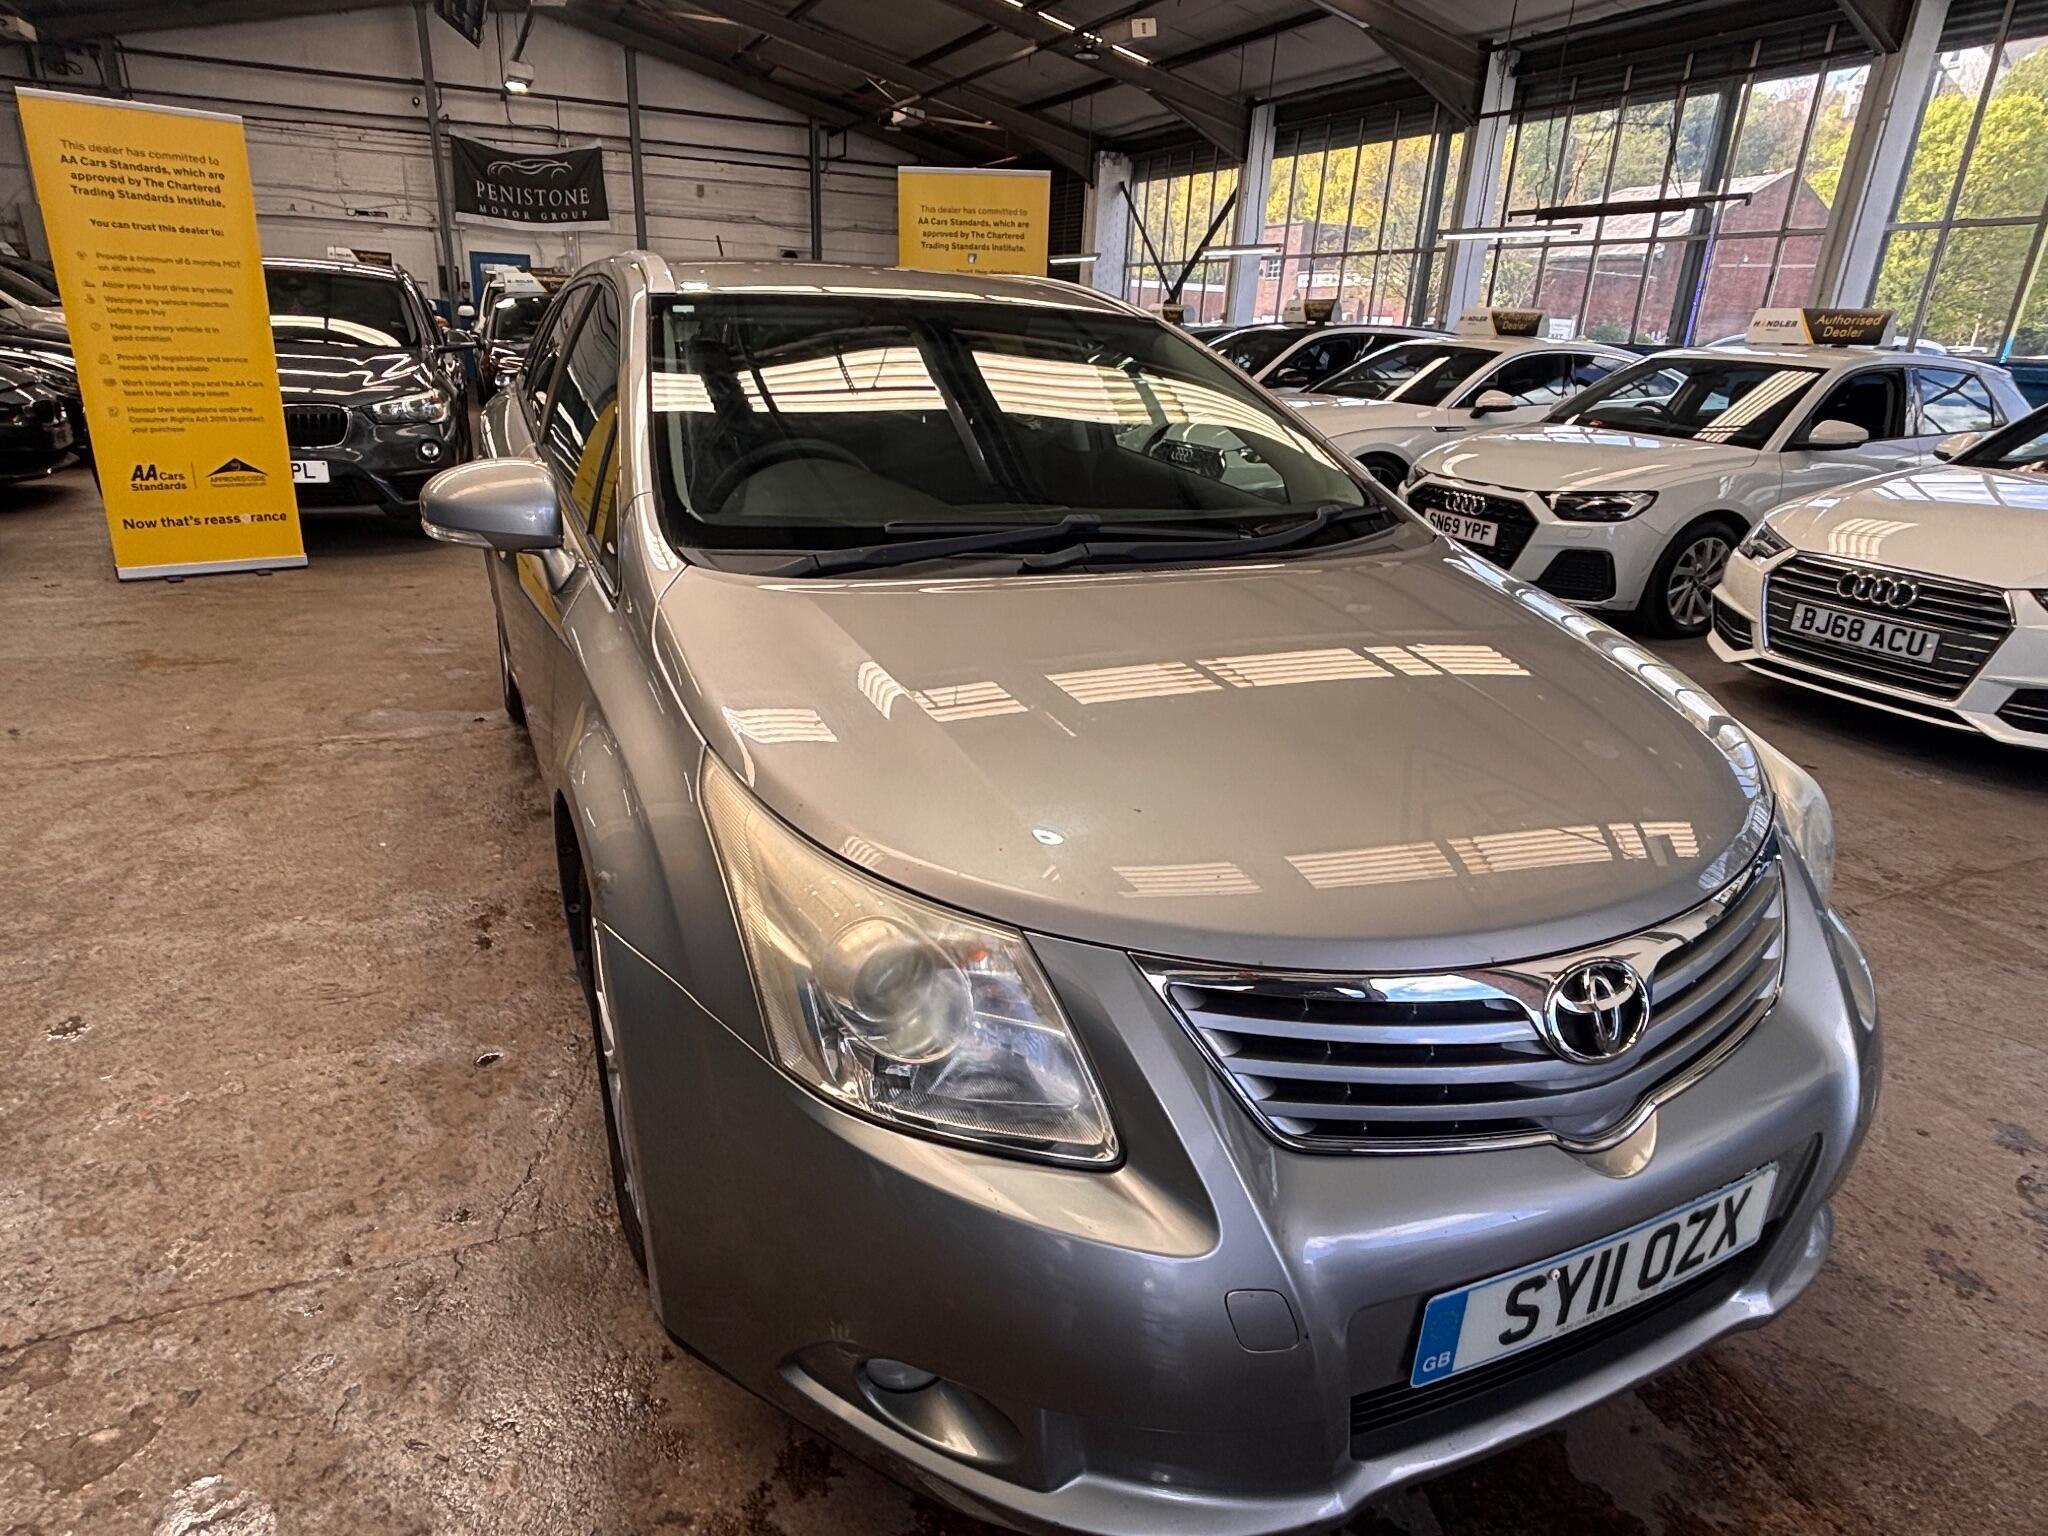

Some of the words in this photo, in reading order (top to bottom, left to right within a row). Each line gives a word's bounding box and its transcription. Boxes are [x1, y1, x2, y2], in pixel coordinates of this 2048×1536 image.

[60, 139, 85, 150] This
[89, 143, 123, 155] dealer
[126, 147, 145, 157] has
[148, 151, 206, 164] committed
[209, 156, 219, 166] to
[61, 154, 78, 164] AA
[80, 157, 107, 167] Cars
[110, 160, 171, 175] Standards,
[173, 167, 205, 177] which
[209, 172, 225, 180] are
[71, 173, 124, 186] approved
[128, 176, 141, 187] by
[143, 177, 164, 188] The
[167, 180, 220, 193] Chartered
[70, 185, 114, 199] Trading
[118, 189, 174, 203] Standards
[476, 180, 590, 206] PENISTONE
[479, 204, 529, 220] MOTOR
[541, 211, 587, 220] GROUP
[89, 218, 109, 228] You
[111, 221, 130, 229] can
[132, 222, 156, 231] trust
[158, 224, 176, 233] this
[180, 226, 209, 235] dealer
[923, 231, 958, 239] approved
[971, 231, 985, 239] The
[987, 232, 1024, 240] Chartered
[921, 242, 949, 251] Trading
[952, 242, 990, 251] Standards
[1815, 314, 1883, 326] Authorised
[1823, 327, 1863, 338] Dealer
[131, 464, 157, 481] AA
[160, 472, 184, 480] Cars
[291, 463, 316, 479] PL
[131, 482, 187, 492] Standards
[123, 519, 157, 529] Now
[161, 516, 200, 527] that's
[204, 512, 287, 525] reassrance
[1429, 512, 1460, 535] SN69
[1465, 521, 1491, 541] YPF
[1800, 607, 1865, 642] BJ68
[1869, 624, 1927, 656] ACU
[1637, 1186, 1752, 1291] OZX
[1423, 1351, 1451, 1372] GB
